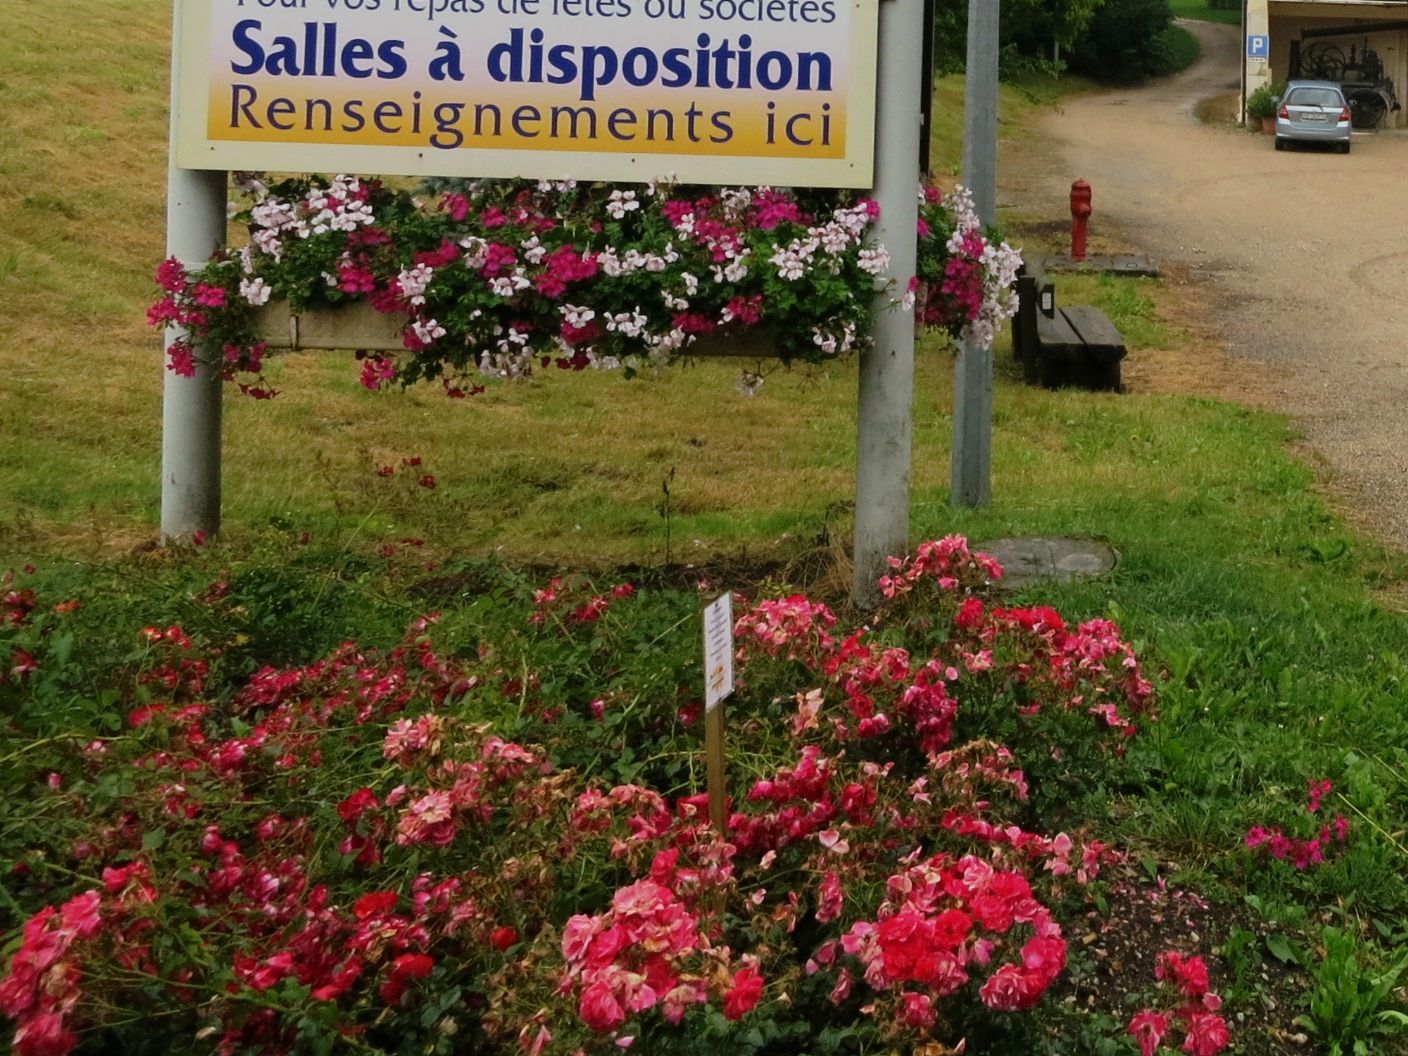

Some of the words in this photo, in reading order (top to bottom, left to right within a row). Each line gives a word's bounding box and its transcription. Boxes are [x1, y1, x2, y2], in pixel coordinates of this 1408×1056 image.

[230, 19, 408, 80] Salles
[428, 25, 465, 82] à
[487, 27, 833, 101] disposition
[1252, 37, 1264, 54] P
[229, 84, 735, 150] Renseignements
[766, 101, 832, 146] ici
